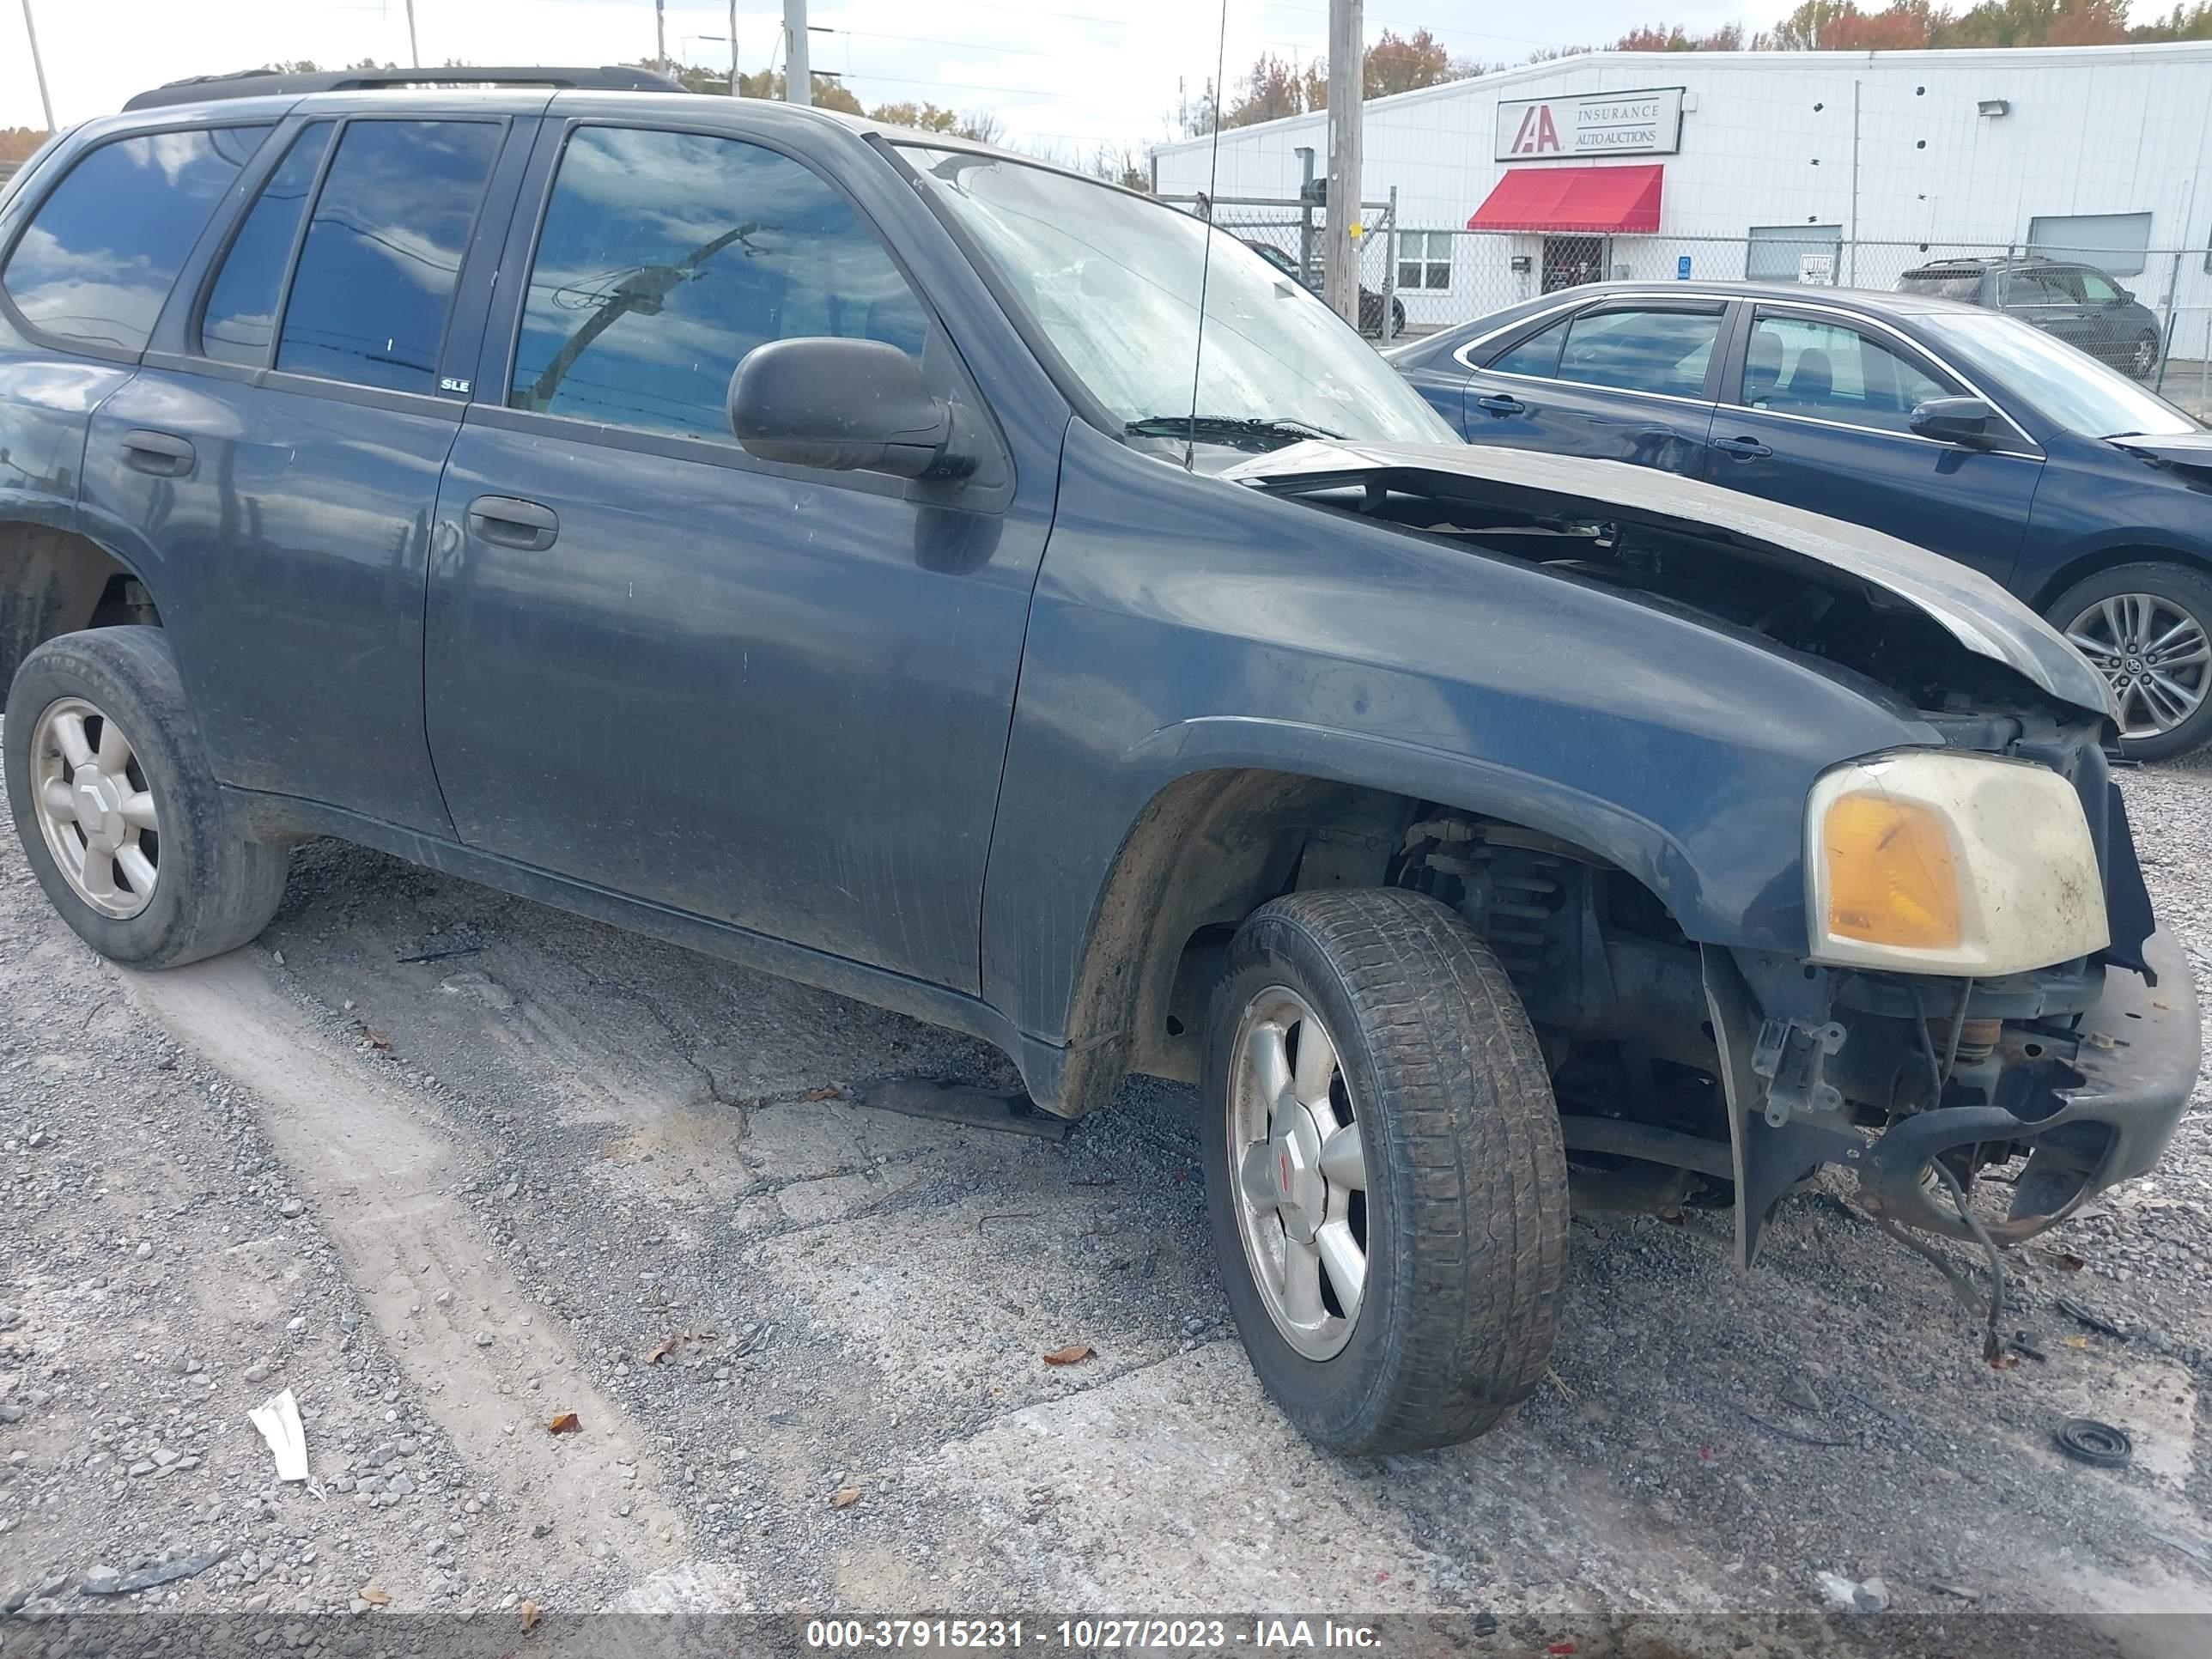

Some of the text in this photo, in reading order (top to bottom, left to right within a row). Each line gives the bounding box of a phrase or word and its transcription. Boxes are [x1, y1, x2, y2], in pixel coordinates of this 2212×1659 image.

[1577, 105, 1659, 121] INSURANCE
[1576, 130, 1656, 145] AUTO AUCTIONS
[1801, 257, 1832, 270] NOTICE
[441, 379, 470, 392] SLE
